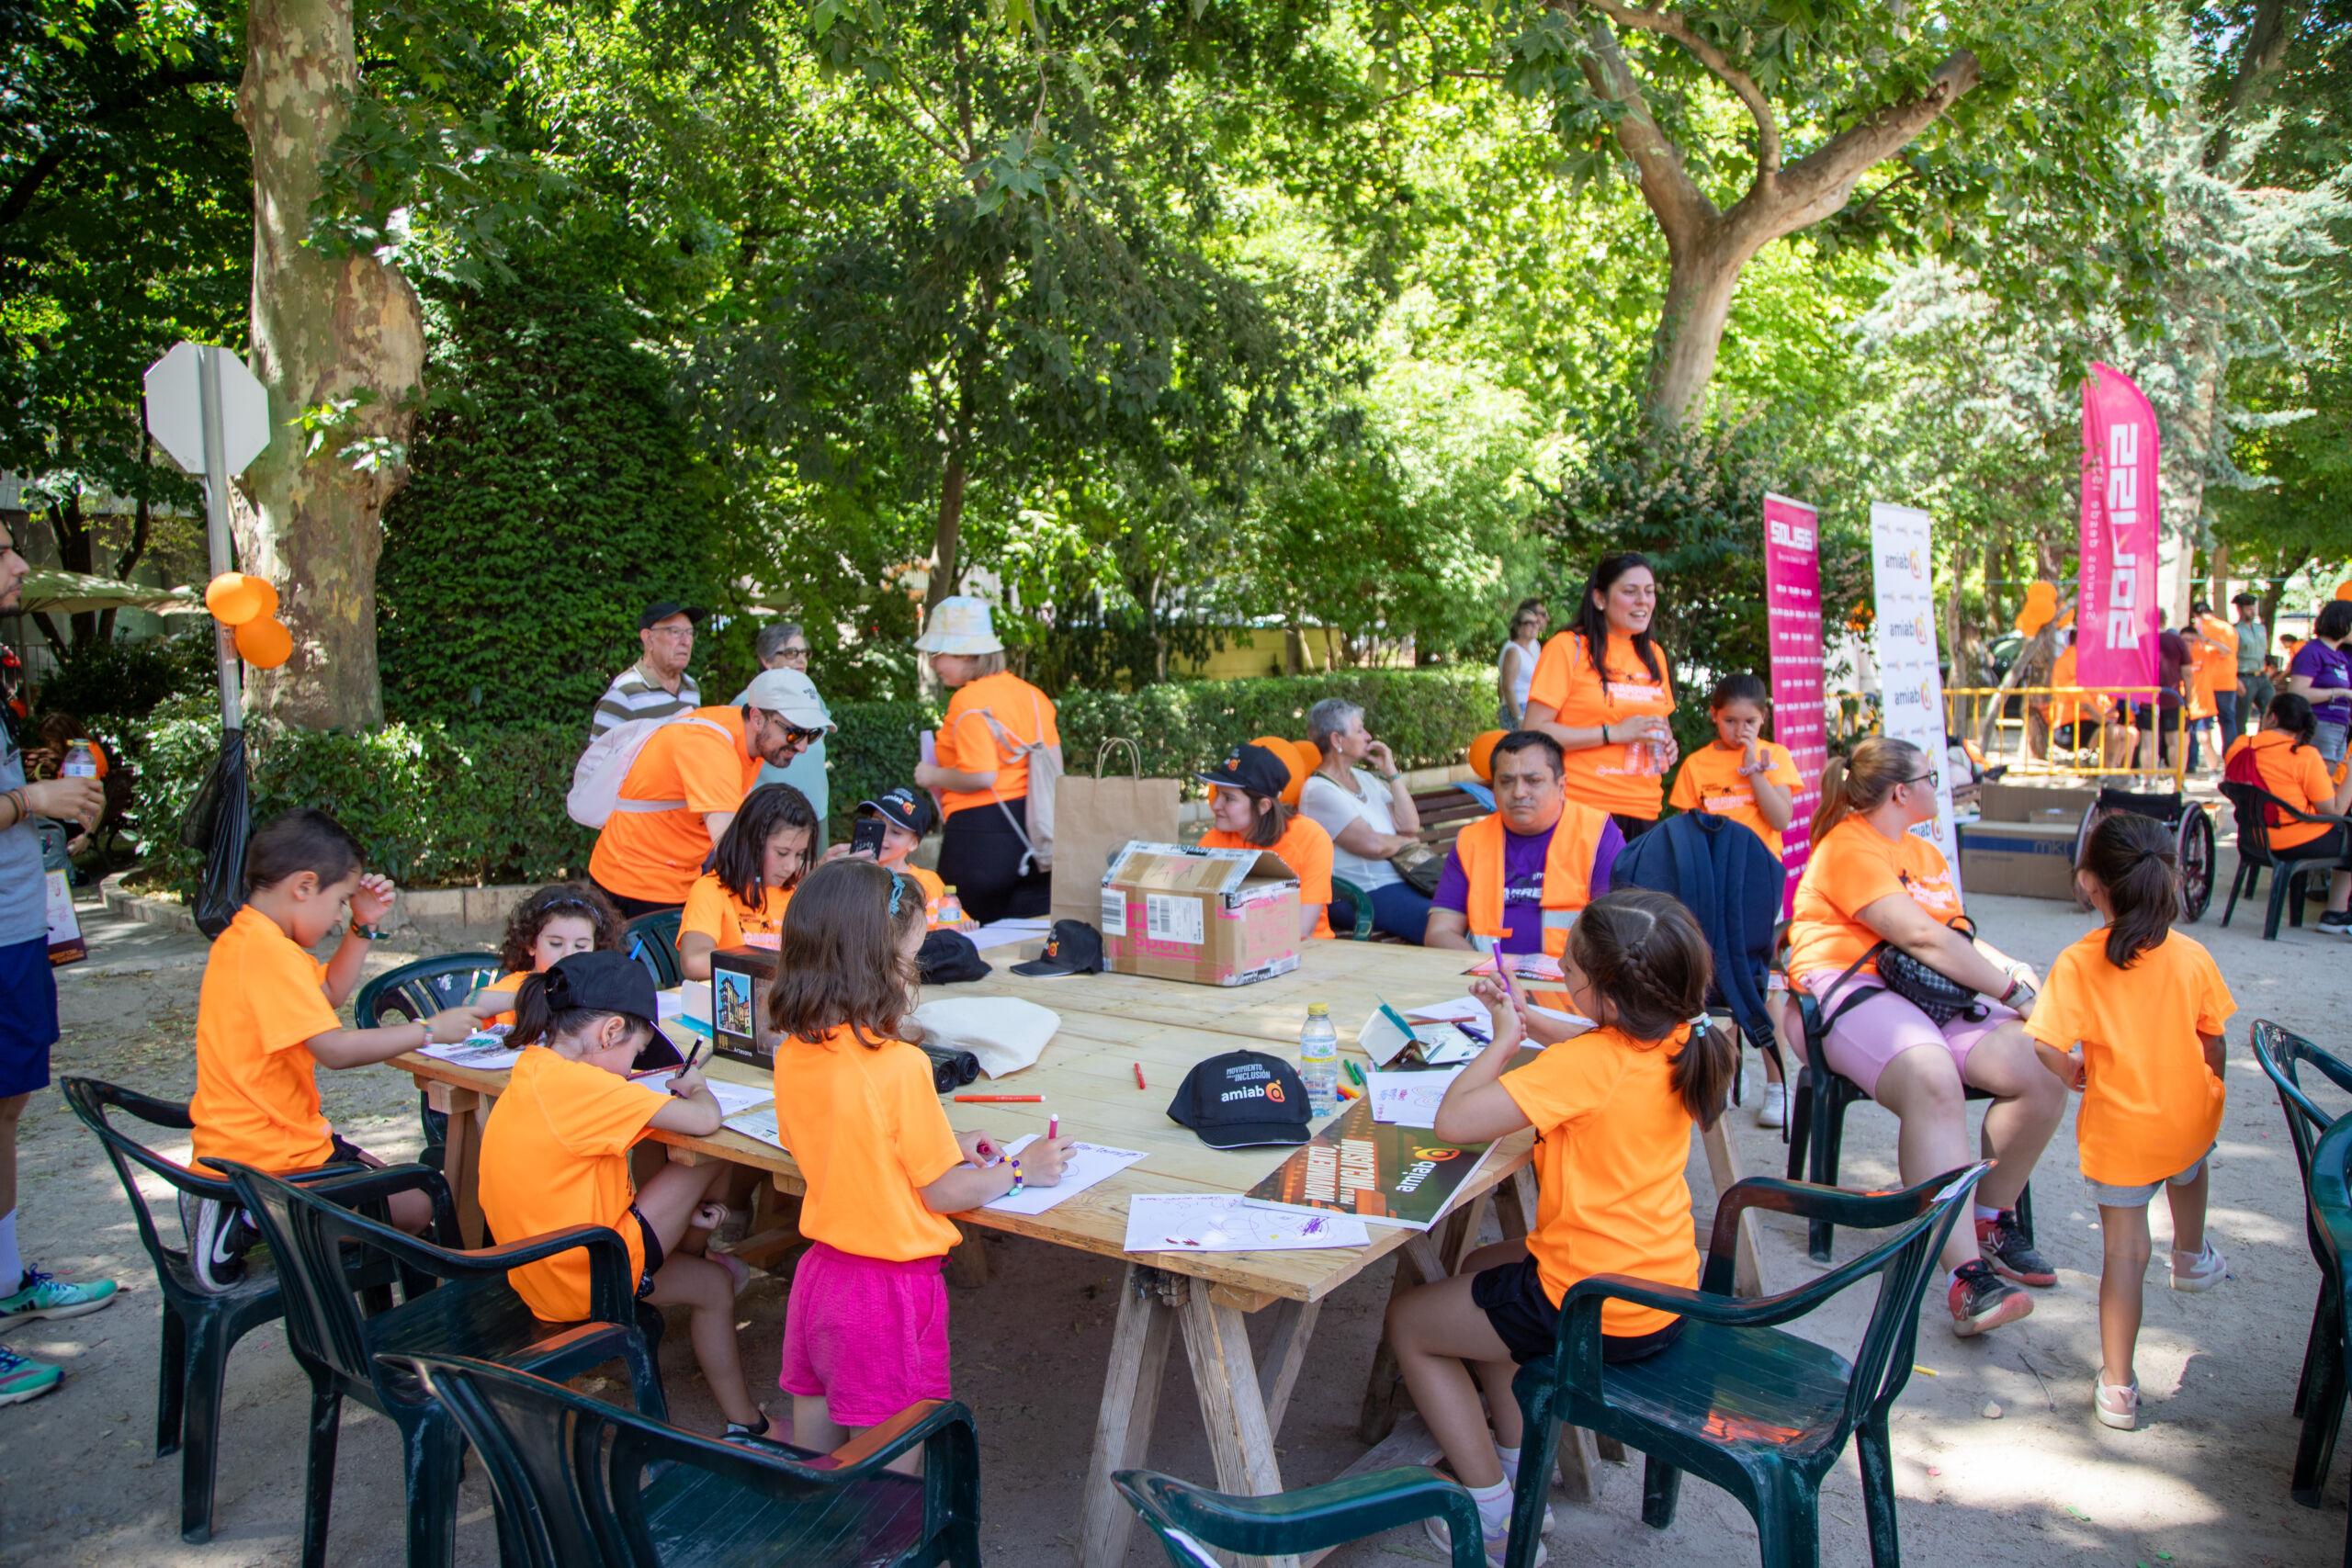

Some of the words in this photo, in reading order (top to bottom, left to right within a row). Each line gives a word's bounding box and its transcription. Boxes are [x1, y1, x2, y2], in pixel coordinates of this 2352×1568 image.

[1770, 520, 1814, 552] SOLISS
[1884, 551, 1910, 570] amiab
[1889, 620, 1916, 637] amiab
[1894, 685, 1921, 705] amiab
[1227, 1064, 1262, 1075] MOVIMIENTO
[1234, 1070, 1271, 1082] INCLUSIÓN
[1221, 1085, 1265, 1102] amiab
[1304, 1145, 1338, 1202] MOVIMIENTO
[1333, 1138, 1375, 1190] INCLUSIÓN
[1394, 1160, 1438, 1193] amiab
